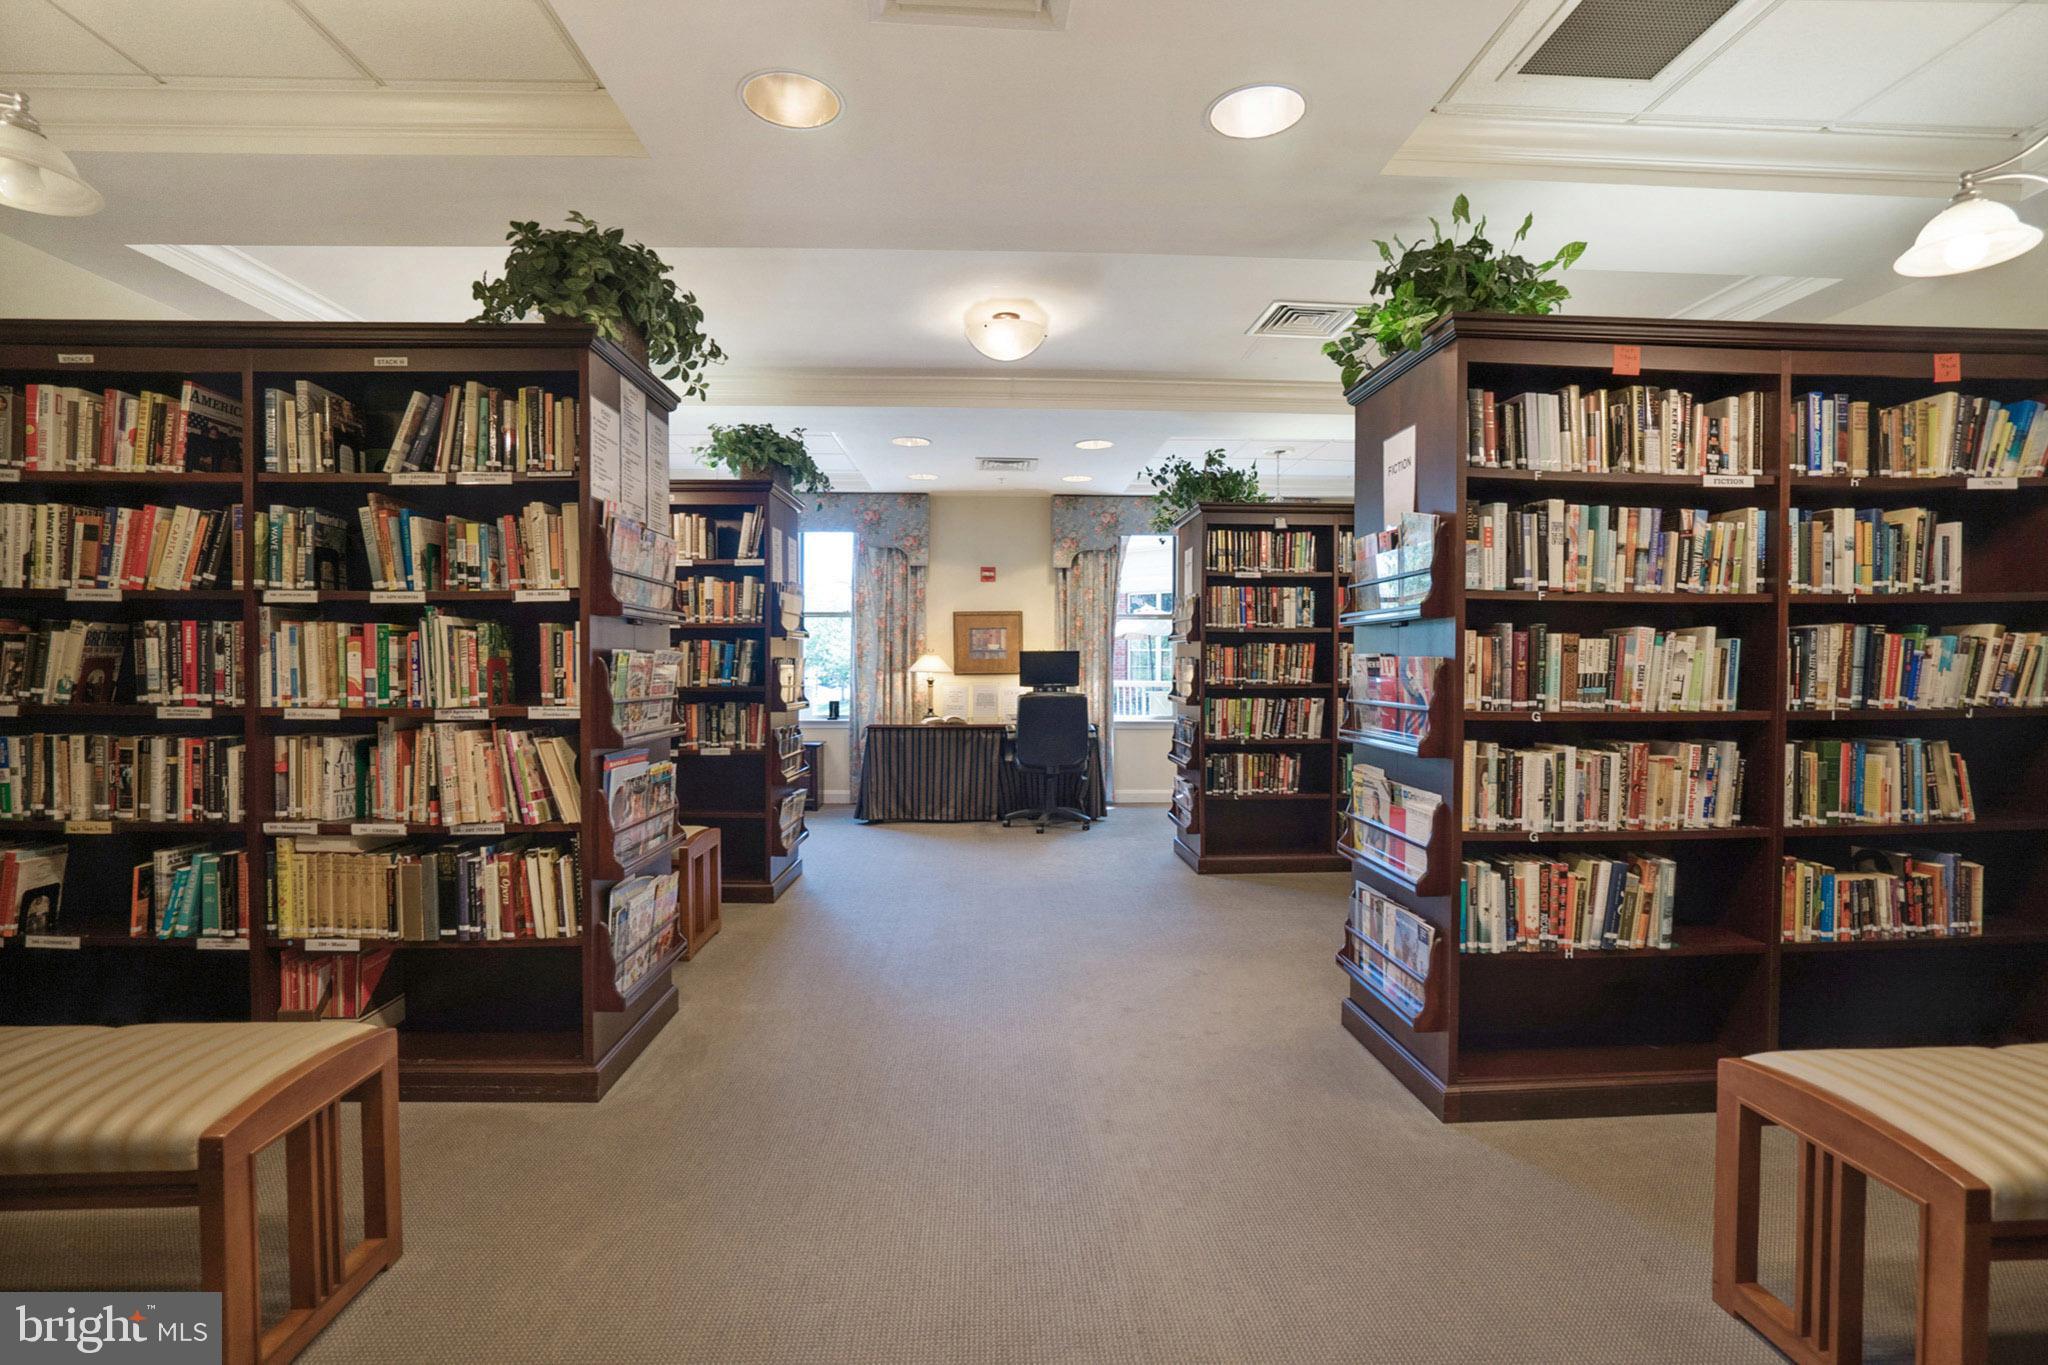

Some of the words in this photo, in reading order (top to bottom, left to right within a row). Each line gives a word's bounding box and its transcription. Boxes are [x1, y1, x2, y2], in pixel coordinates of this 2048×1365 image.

[1637, 406, 1645, 433] FOLLETT
[1387, 456, 1412, 477] FICTION
[1534, 471, 1542, 480] F
[46, 511, 55, 536] MONEY
[165, 522, 181, 561] CAPITAL
[270, 526, 279, 550] WAVE
[1538, 588, 1546, 600] F
[469, 640, 477, 655] Alex
[1531, 711, 1541, 722] G
[1965, 708, 1973, 718] J
[1528, 831, 1539, 842] G
[500, 877, 511, 905] Opera
[1565, 948, 1573, 959] H
